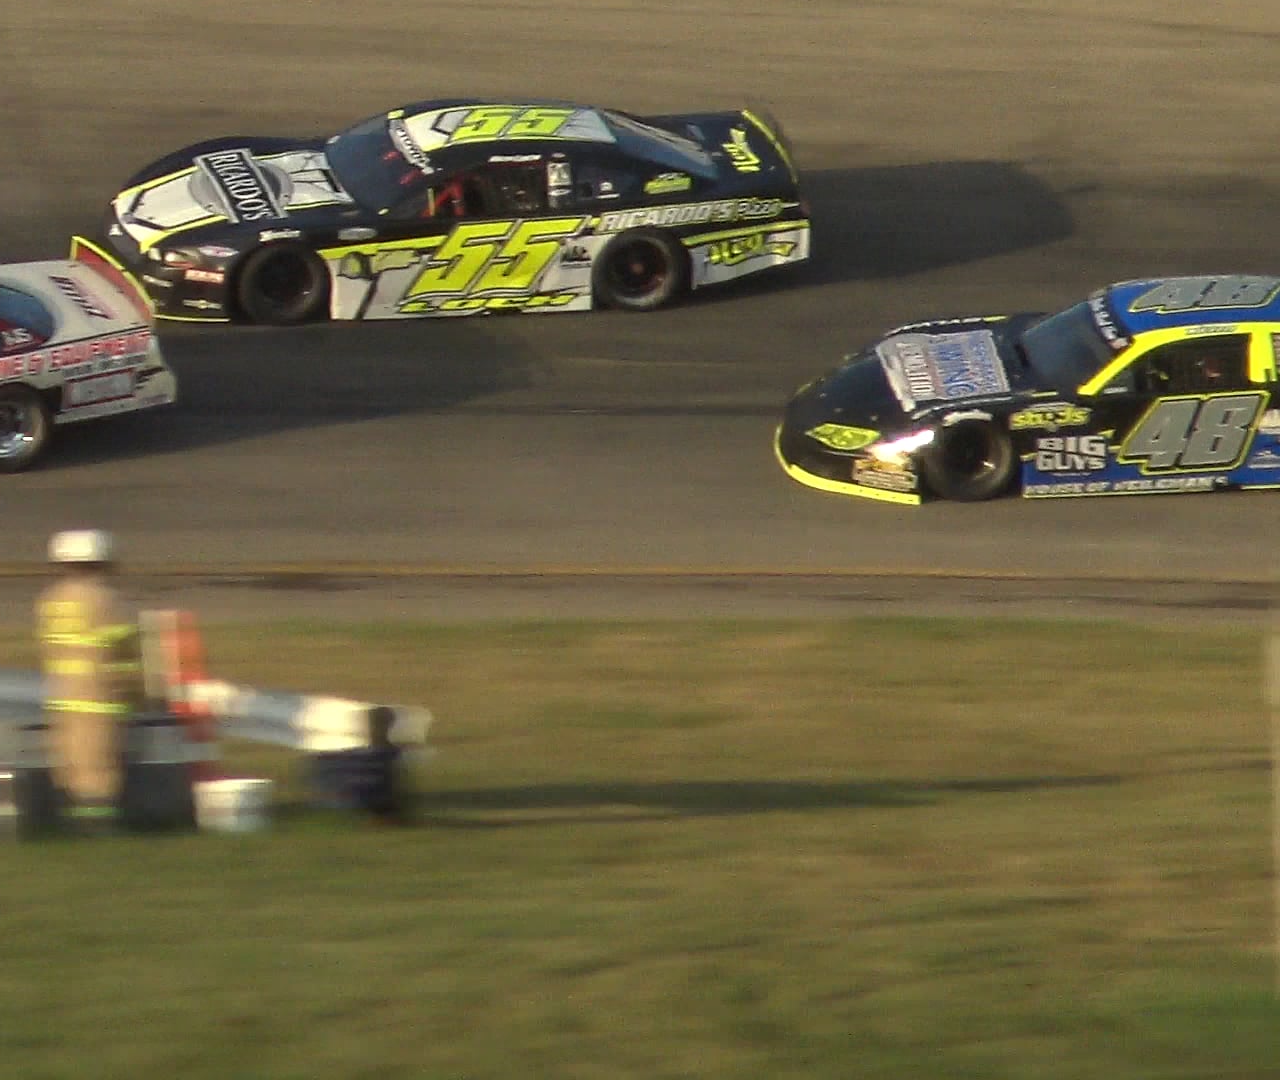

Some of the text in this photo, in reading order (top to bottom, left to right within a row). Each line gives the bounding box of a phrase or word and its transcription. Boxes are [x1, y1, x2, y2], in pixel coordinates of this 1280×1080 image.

[450, 108, 575, 140] 55
[207, 152, 274, 221] RICARDO'S
[406, 218, 583, 297] 55
[1130, 275, 1279, 313] 48
[1038, 436, 1106, 456] BIG
[1121, 393, 1266, 473] 48
